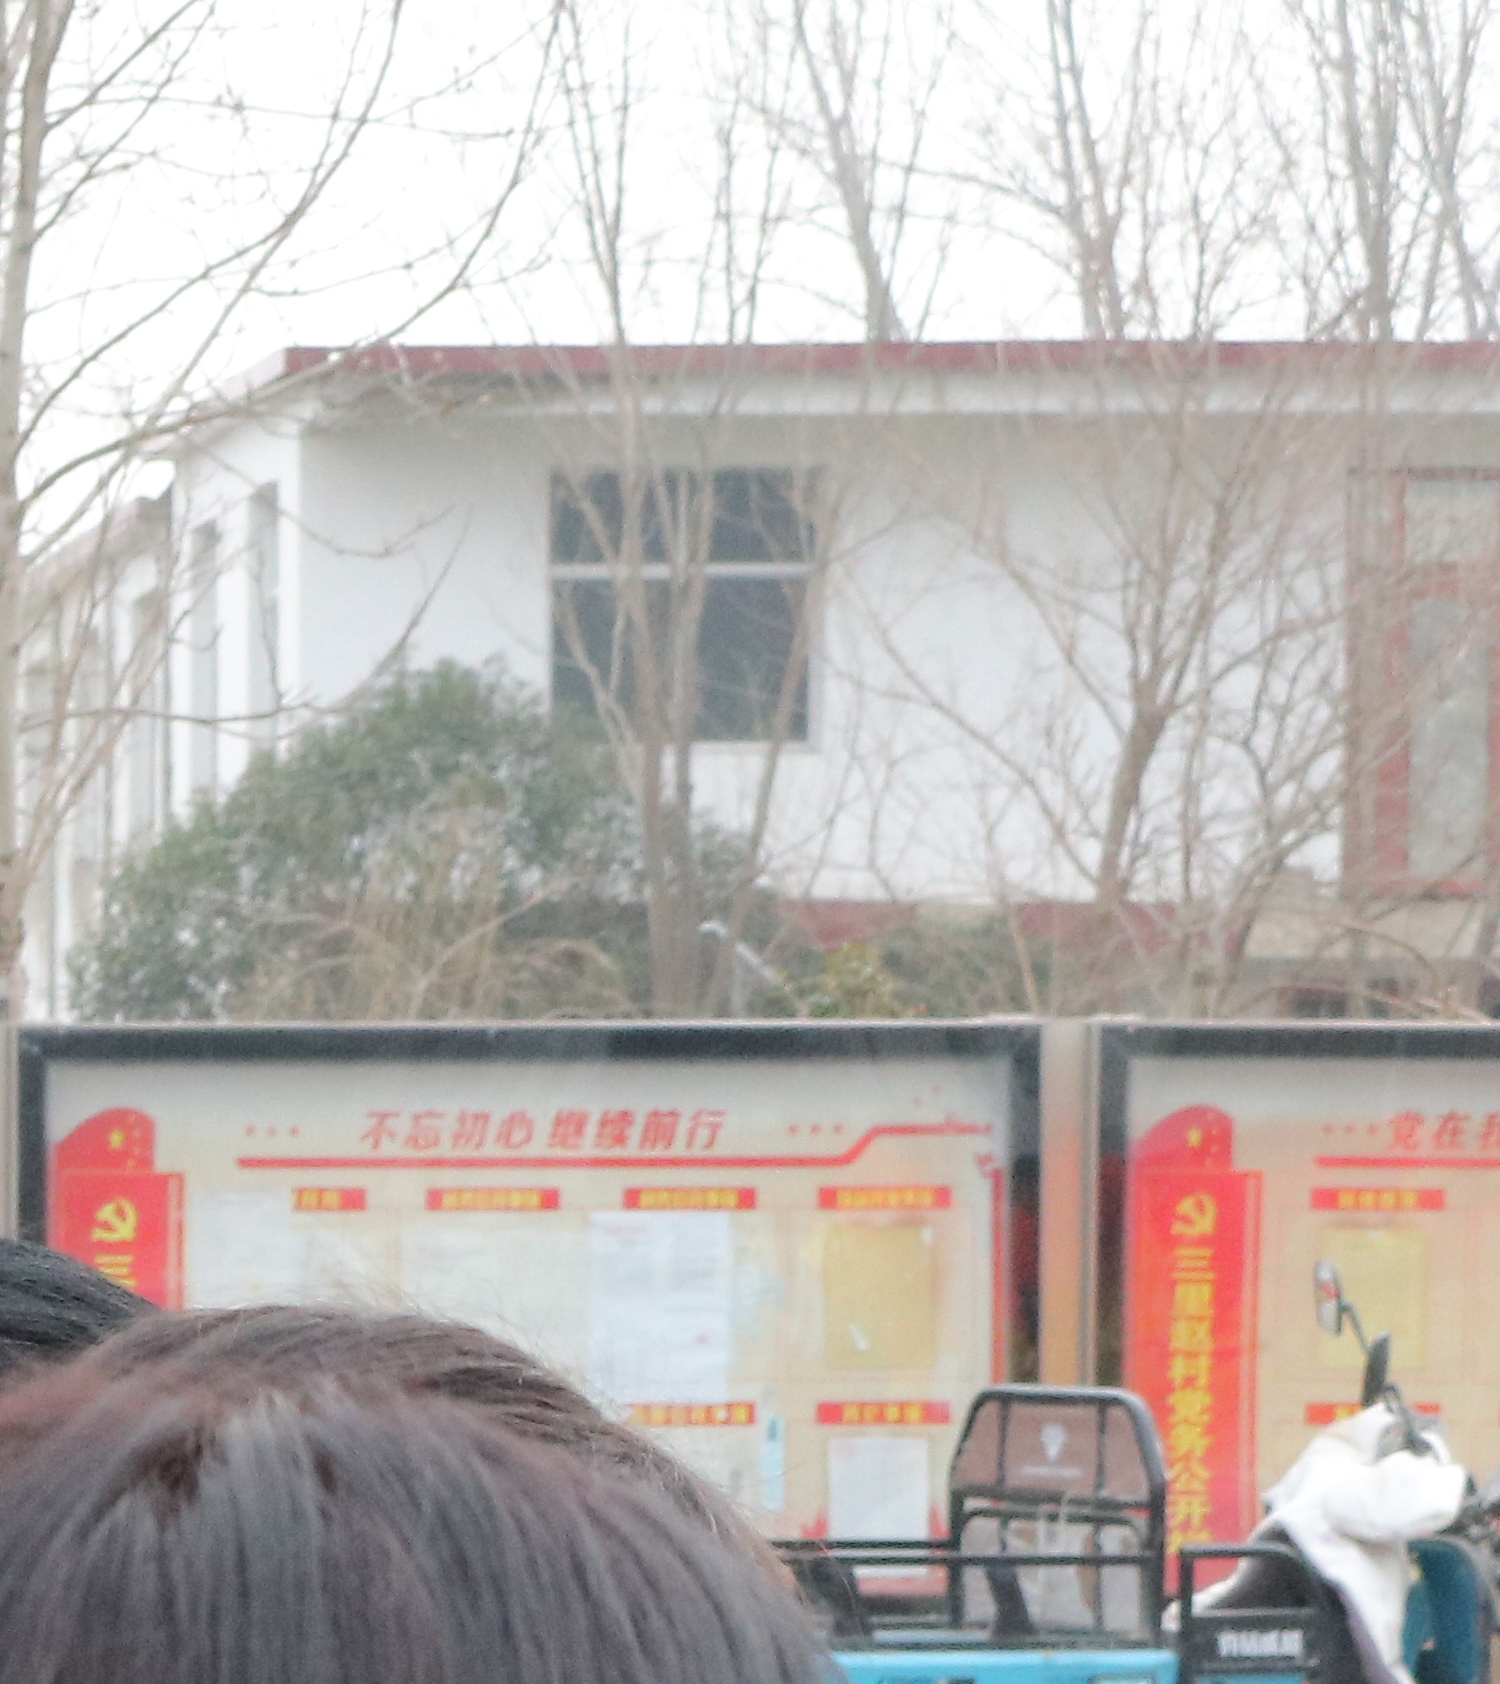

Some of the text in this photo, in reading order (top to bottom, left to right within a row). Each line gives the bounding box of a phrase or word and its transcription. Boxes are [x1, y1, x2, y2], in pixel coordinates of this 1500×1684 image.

[359, 1108, 728, 1150] 不忘初心 继续前行
